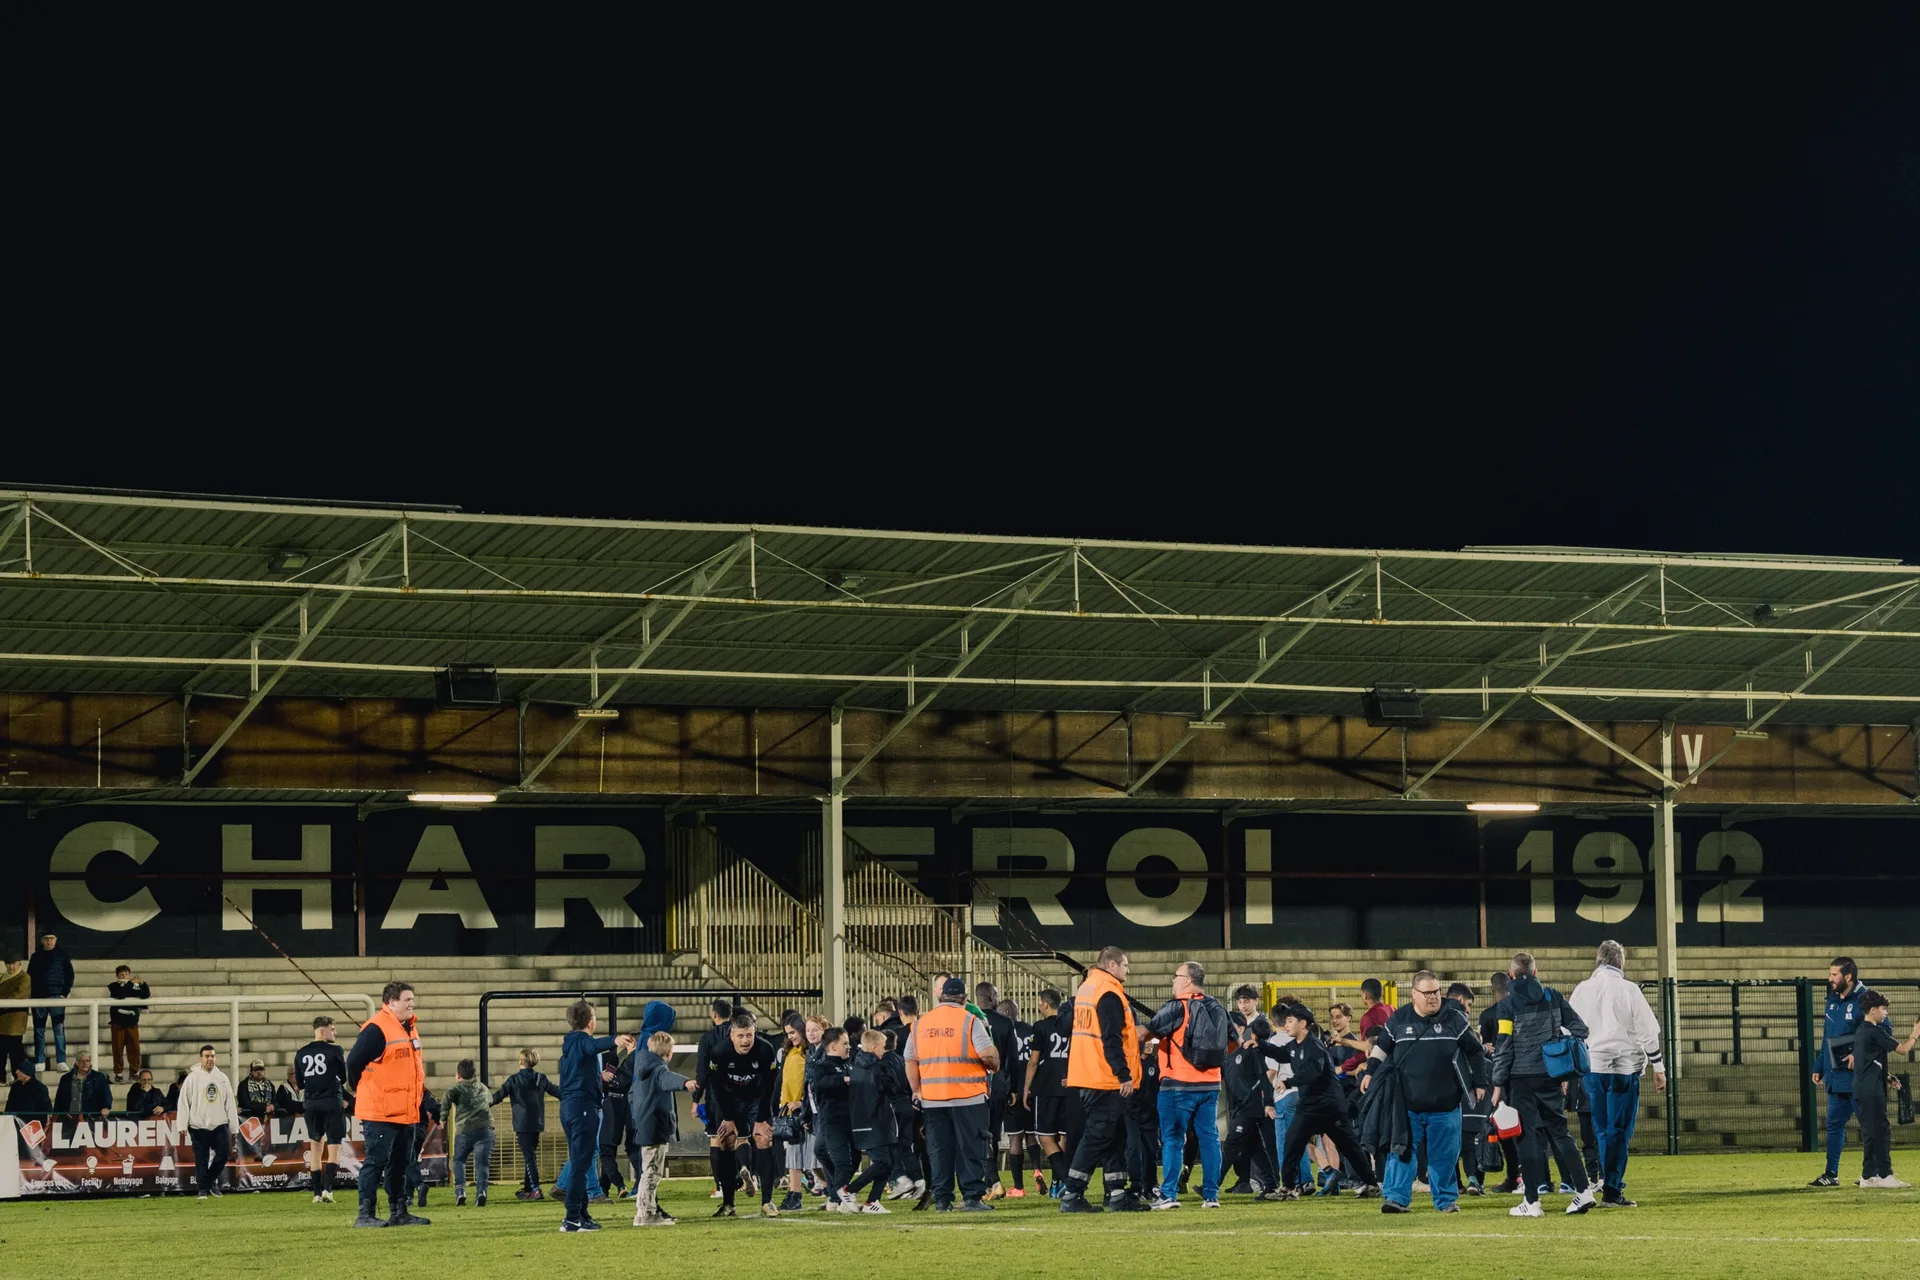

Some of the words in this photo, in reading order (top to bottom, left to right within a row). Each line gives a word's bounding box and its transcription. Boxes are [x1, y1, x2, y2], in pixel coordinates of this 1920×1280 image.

[1681, 734, 1703, 784] V
[302, 1053, 327, 1077] 28
[52, 1120, 193, 1149] LAUREN
[81, 1177, 103, 1189] Facility
[113, 1176, 144, 1187] Nettoyage
[155, 1175, 179, 1187] Balayage
[251, 1174, 273, 1183] Espaces
[274, 1173, 288, 1182] verts
